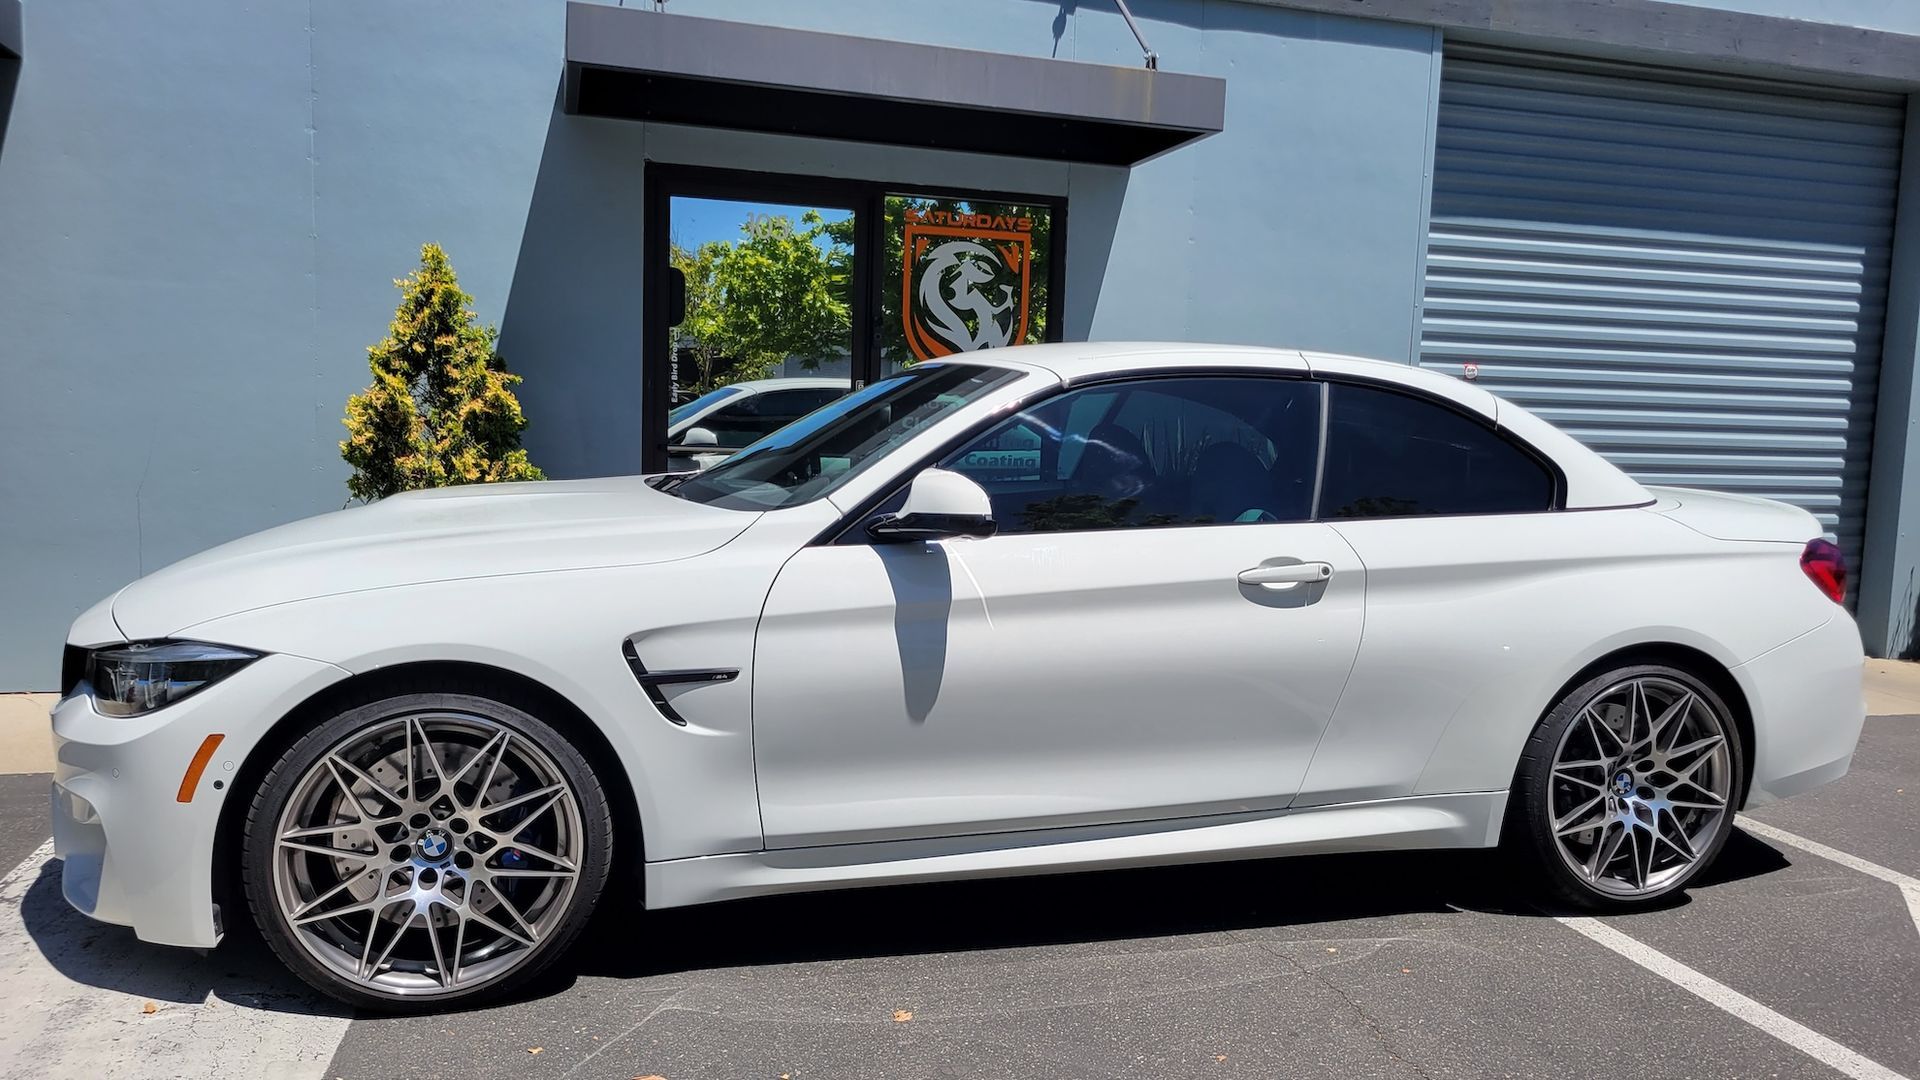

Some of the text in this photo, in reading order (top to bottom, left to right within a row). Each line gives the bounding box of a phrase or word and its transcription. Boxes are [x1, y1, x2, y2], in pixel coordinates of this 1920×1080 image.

[904, 208, 1032, 231] SATURDAYS
[671, 342, 680, 362] Drop
[964, 453, 1036, 469] Coating
